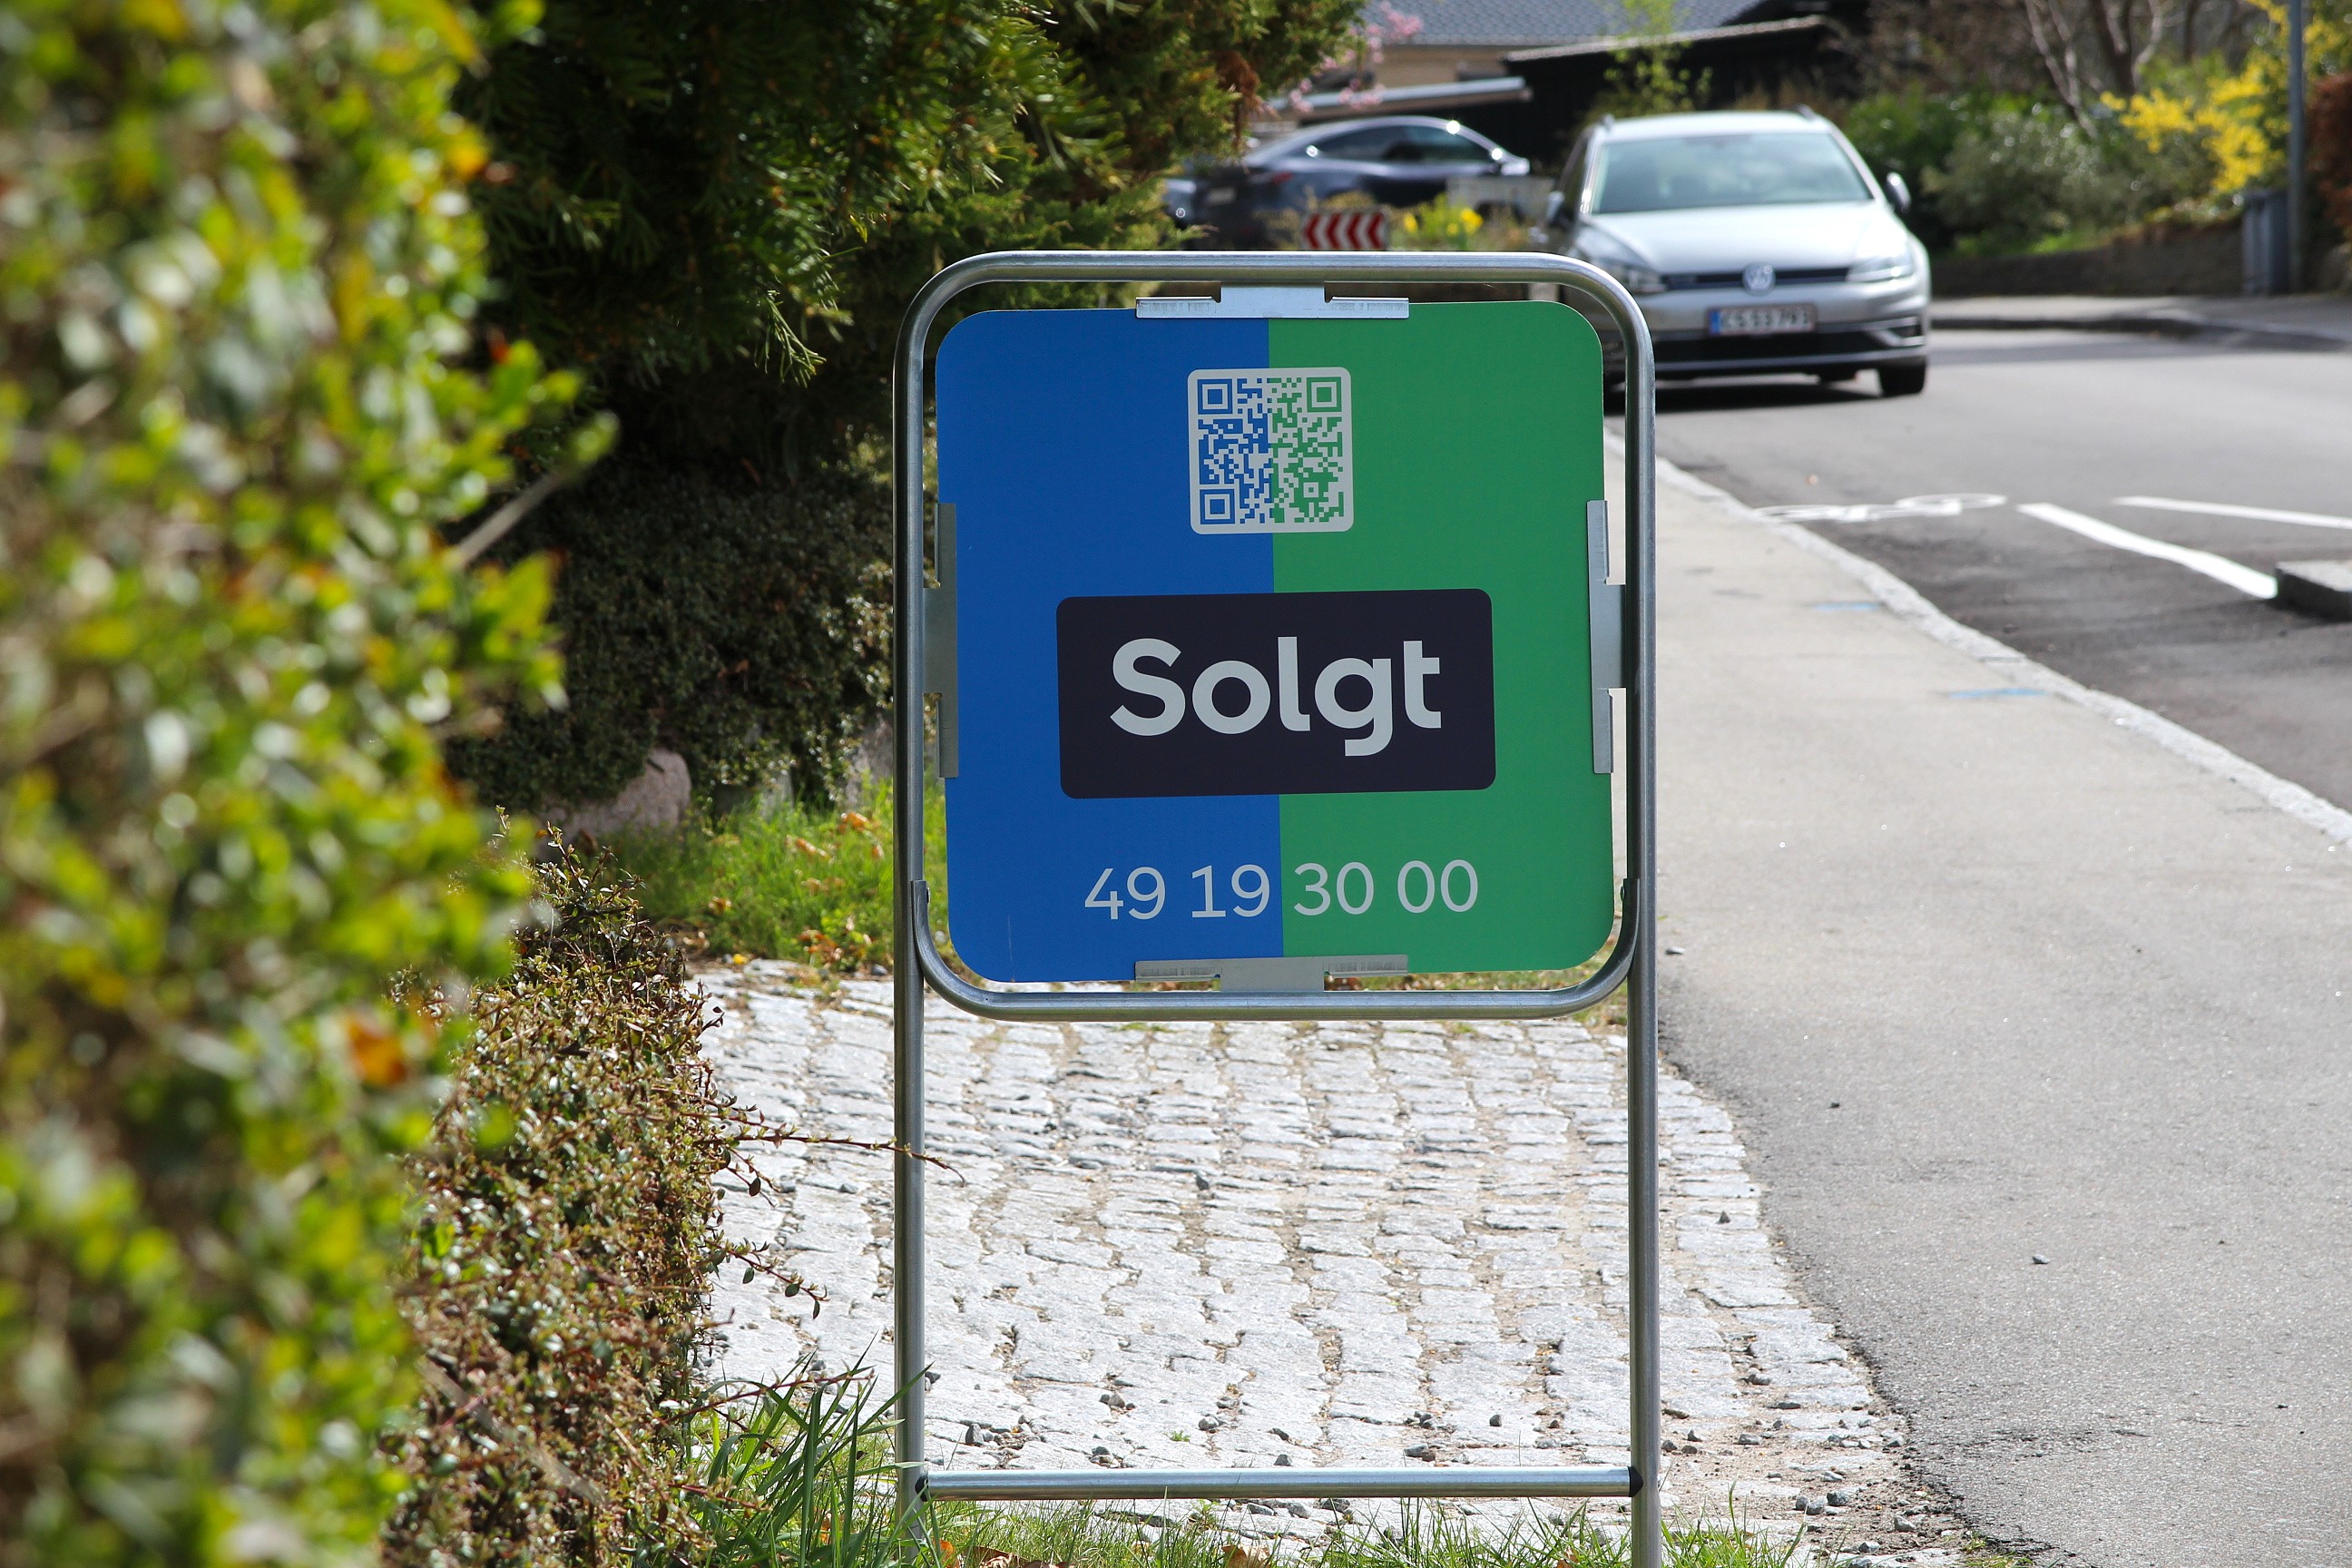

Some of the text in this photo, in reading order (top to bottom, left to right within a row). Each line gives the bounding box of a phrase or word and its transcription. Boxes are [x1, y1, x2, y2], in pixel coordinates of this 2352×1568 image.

[1110, 636, 1442, 757] Solgt
[1084, 859, 1478, 920] 49 19 30 00
